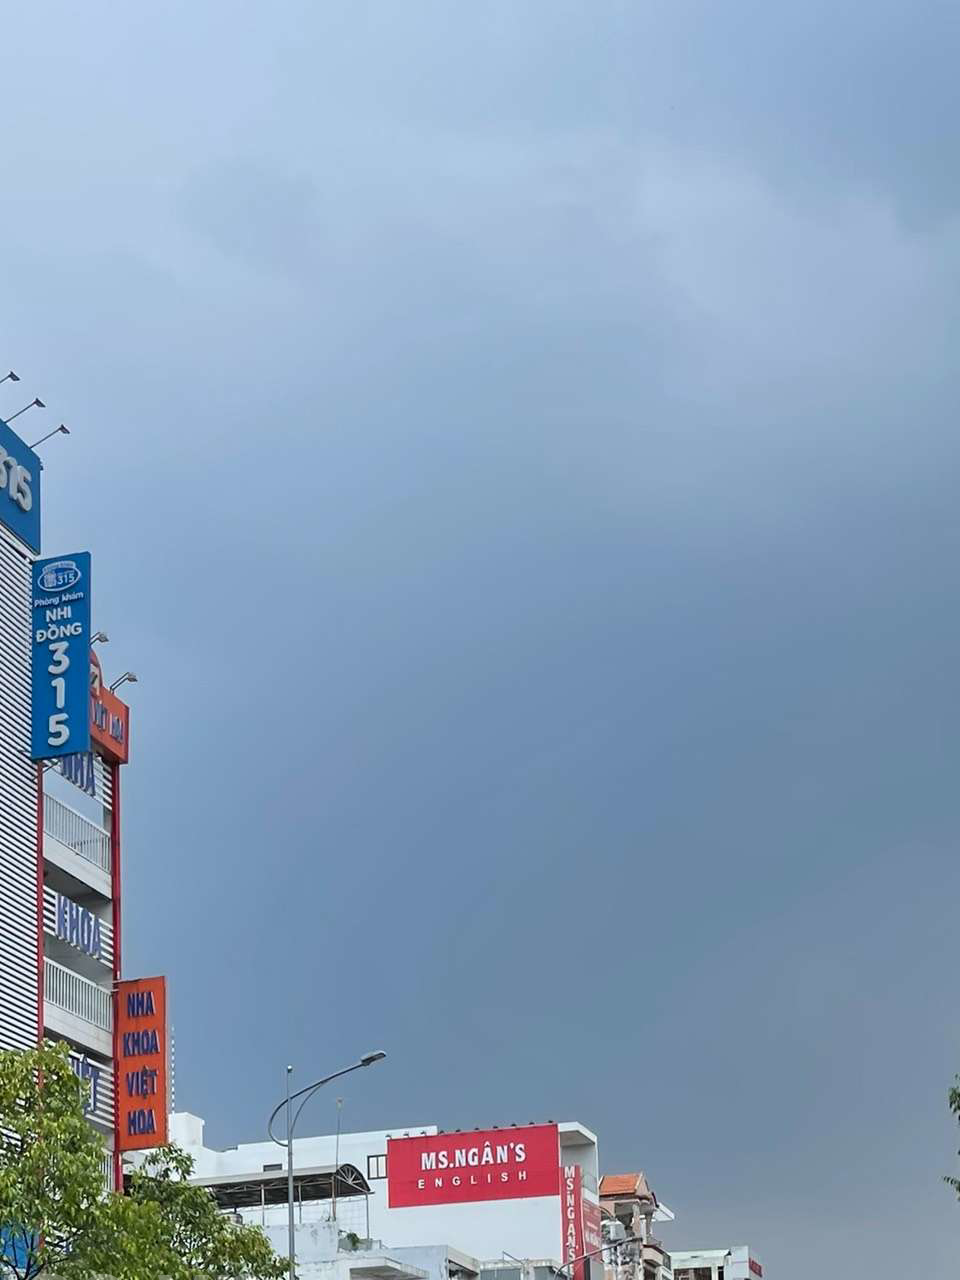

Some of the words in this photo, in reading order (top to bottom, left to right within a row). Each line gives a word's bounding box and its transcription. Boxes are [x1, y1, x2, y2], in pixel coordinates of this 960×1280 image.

[45, 605, 72, 622] NHI
[36, 622, 83, 642] ĐỒNG
[123, 1029, 160, 1057] KHOA
